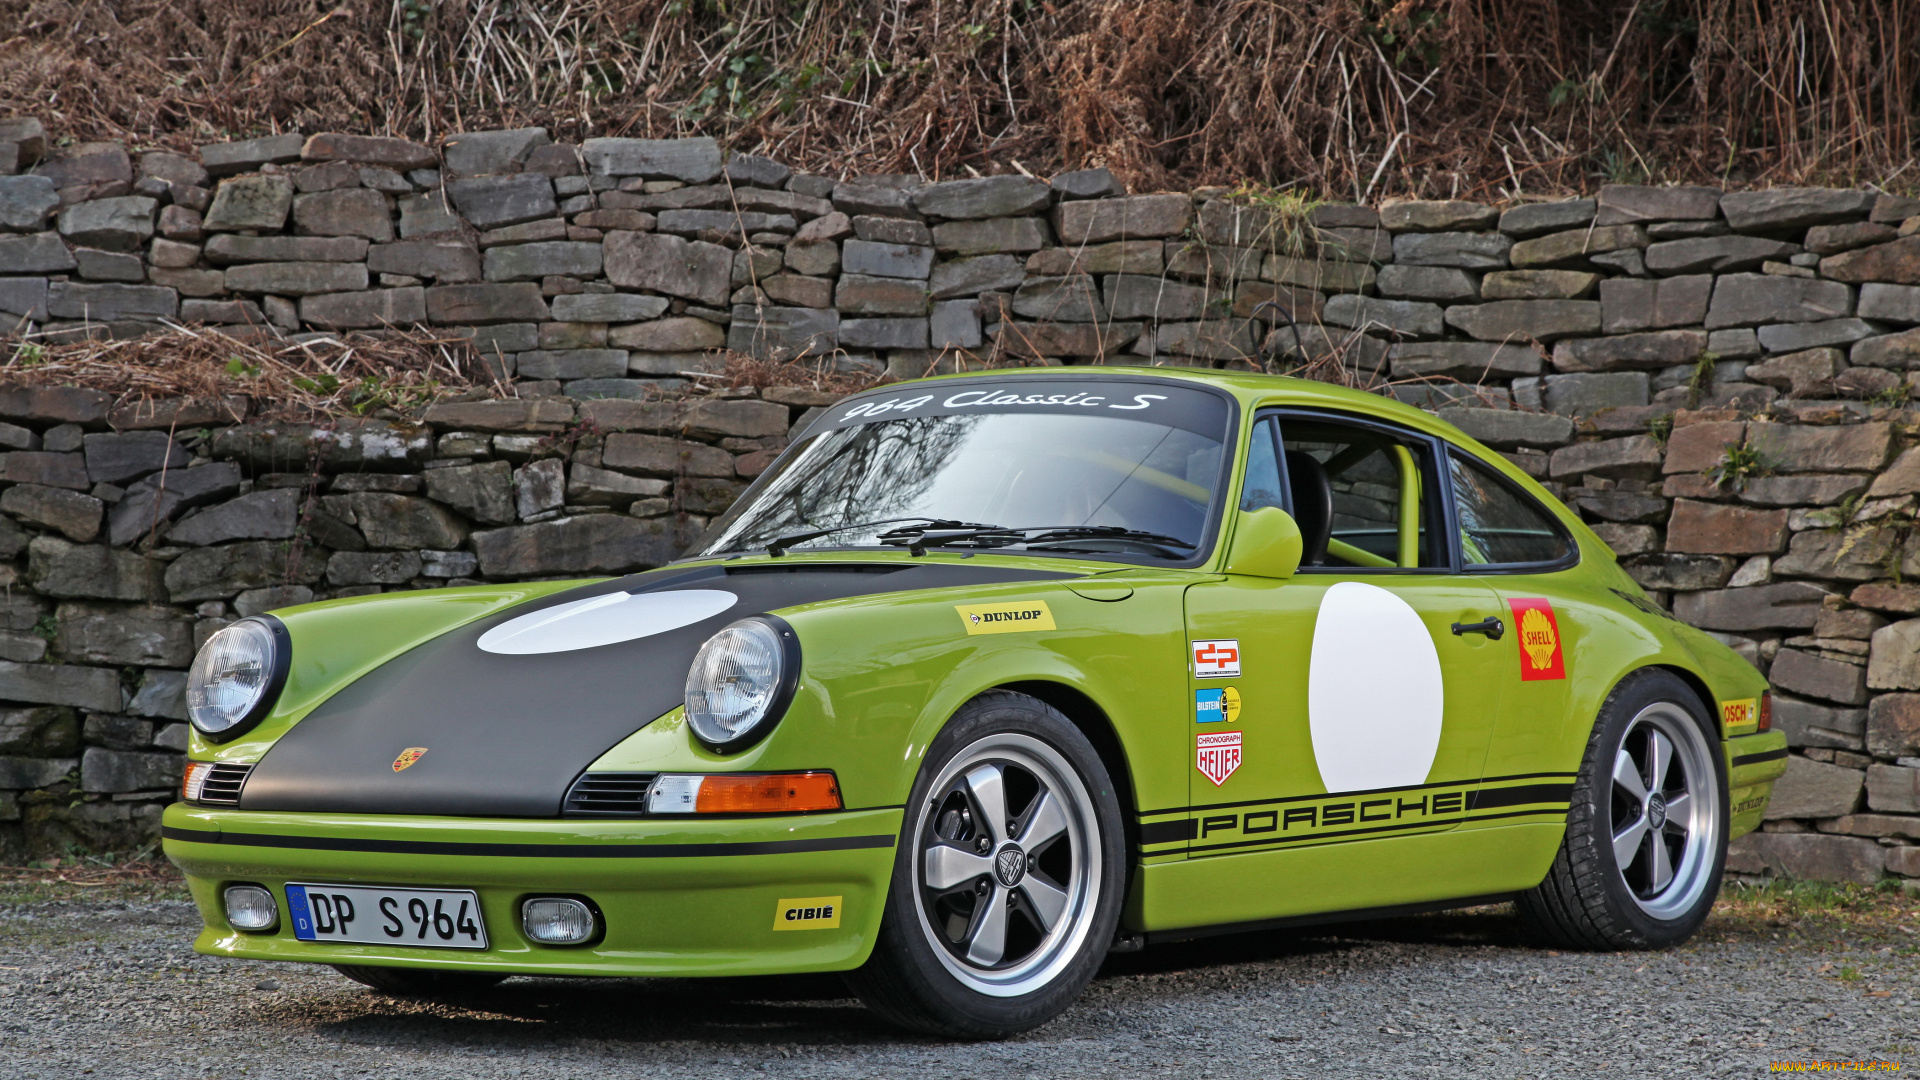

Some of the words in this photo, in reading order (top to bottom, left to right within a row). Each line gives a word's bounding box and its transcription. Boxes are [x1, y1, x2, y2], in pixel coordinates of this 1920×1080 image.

[838, 394, 935, 423] 964
[943, 389, 1106, 409] Classic
[1109, 393, 1168, 411] S
[983, 610, 1042, 623] DUNLOP
[1526, 631, 1552, 646] SHELL
[1197, 701, 1220, 711] BILSTEIN
[1198, 734, 1241, 745] CHRONOGRAPH
[1199, 748, 1240, 783] HEUER
[1201, 791, 1463, 839] PORSCHE
[308, 893, 355, 935] DP
[299, 918, 308, 930] D
